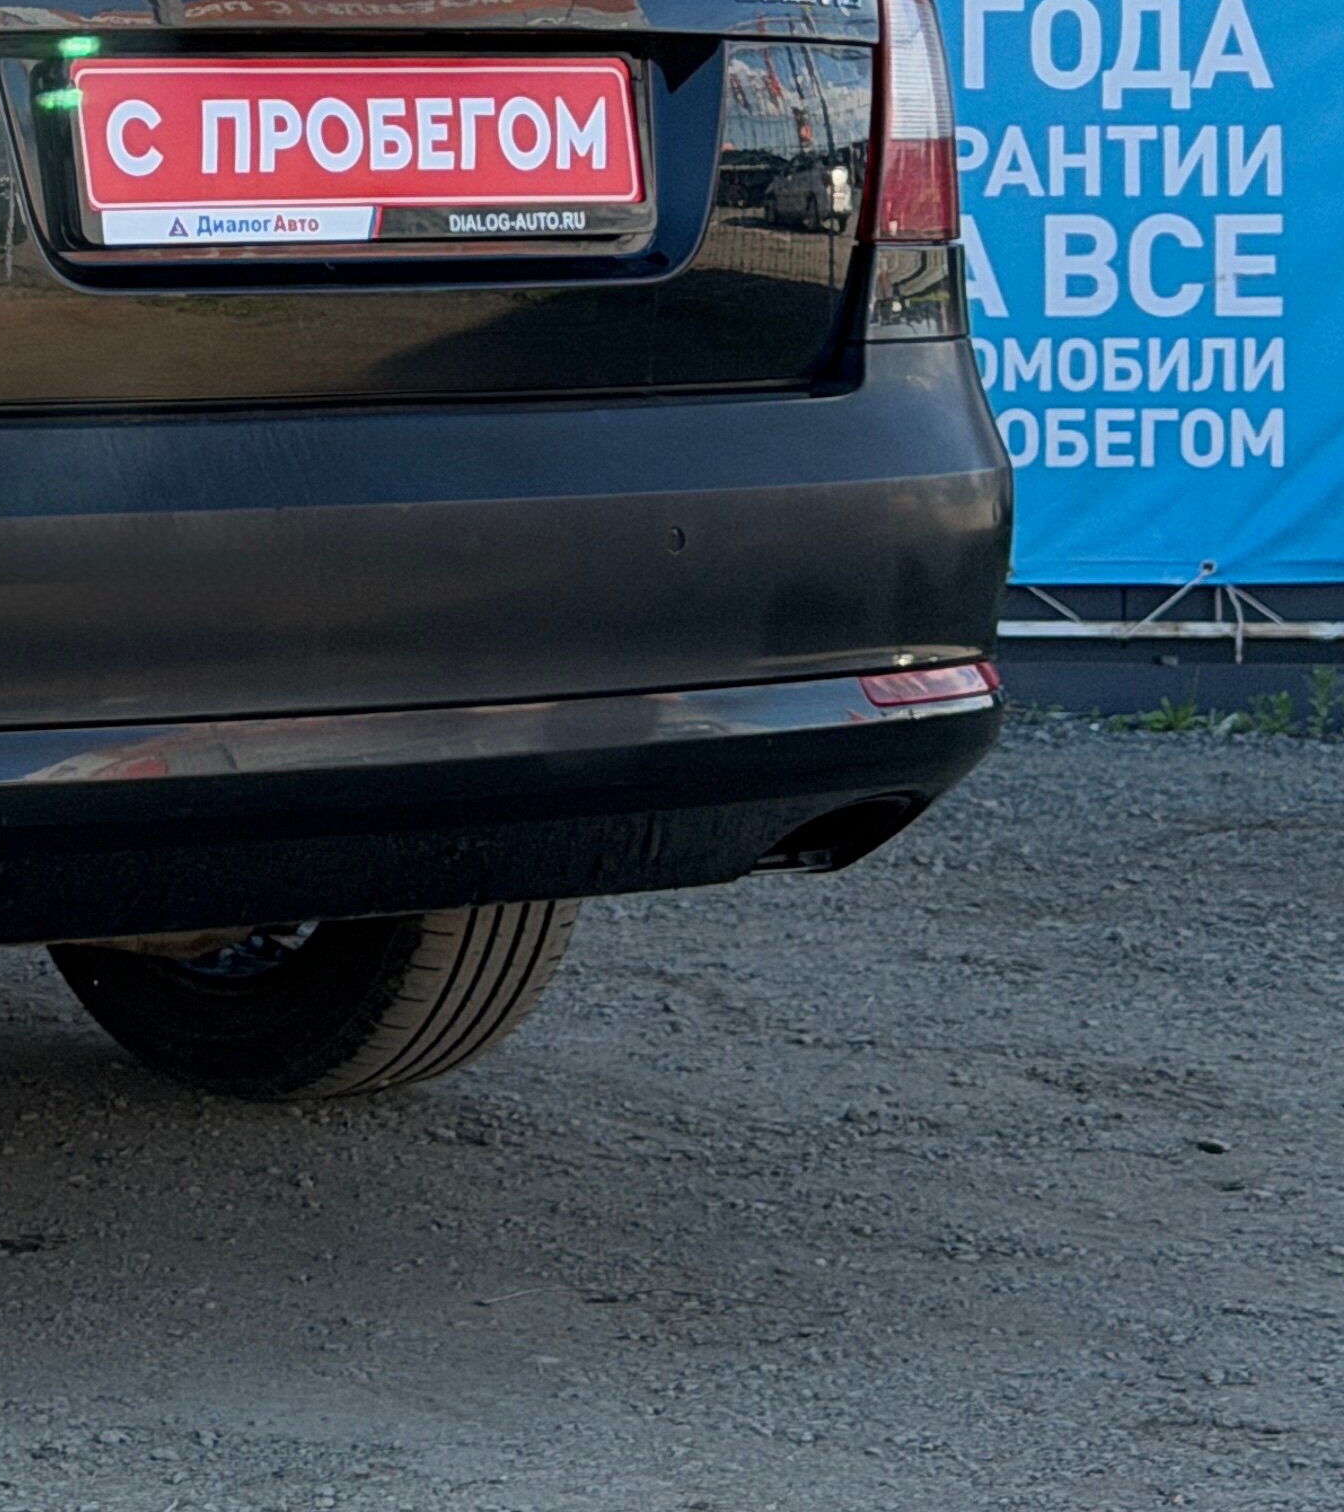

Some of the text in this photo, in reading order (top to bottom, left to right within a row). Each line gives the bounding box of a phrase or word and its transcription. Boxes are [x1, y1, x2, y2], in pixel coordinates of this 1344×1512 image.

[105, 95, 608, 178] С ПРОБЕГОМ
[448, 210, 586, 233] DIALOG-AUTO.RU
[1045, 214, 1282, 317] ВСЕ
